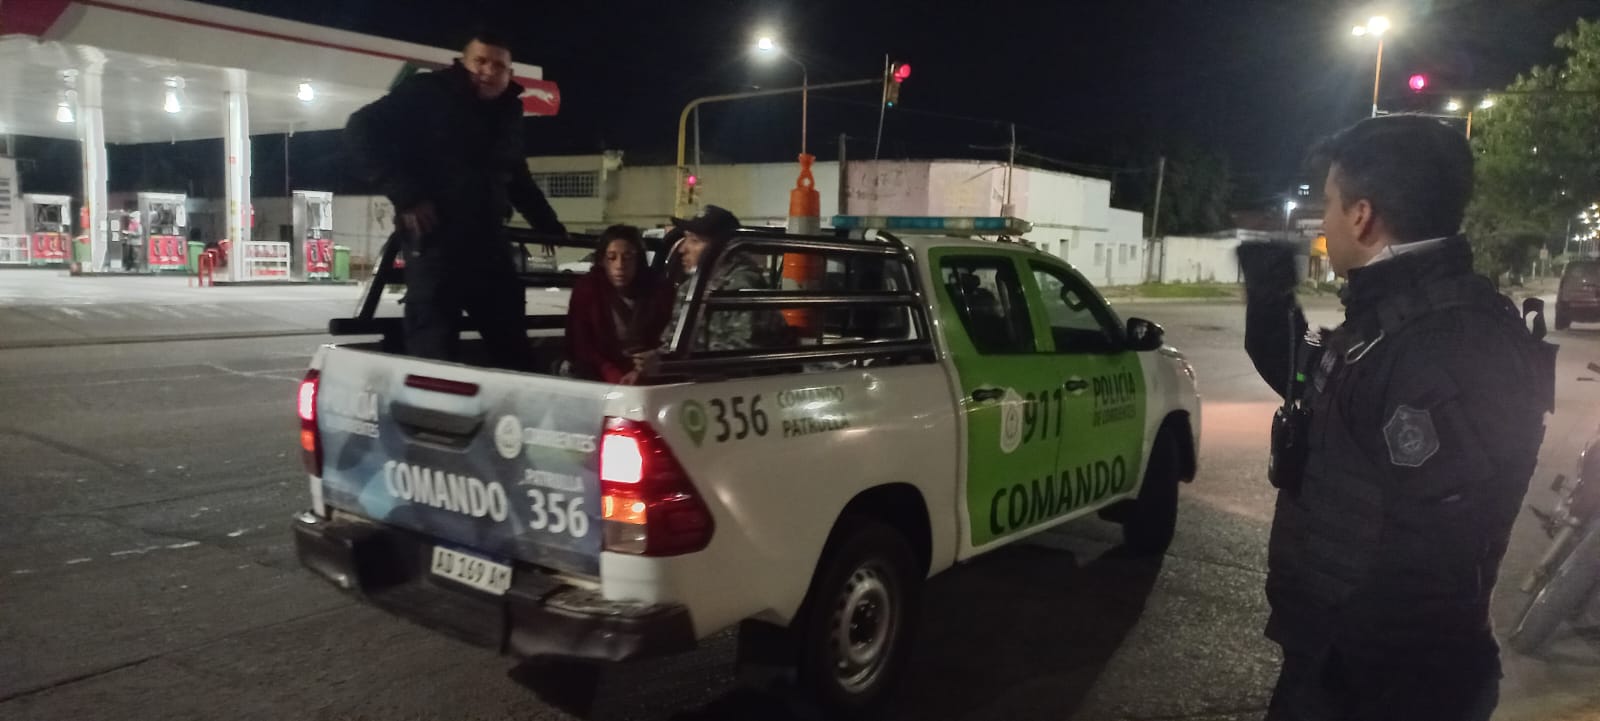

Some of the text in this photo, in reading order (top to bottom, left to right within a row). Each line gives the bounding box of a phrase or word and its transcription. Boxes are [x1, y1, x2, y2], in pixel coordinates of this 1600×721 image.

[710, 394, 768, 443] 356
[1023, 388, 1063, 444] 911
[384, 460, 508, 522] COMANDO
[527, 489, 589, 538] 356
[989, 455, 1126, 536] COMANDO
